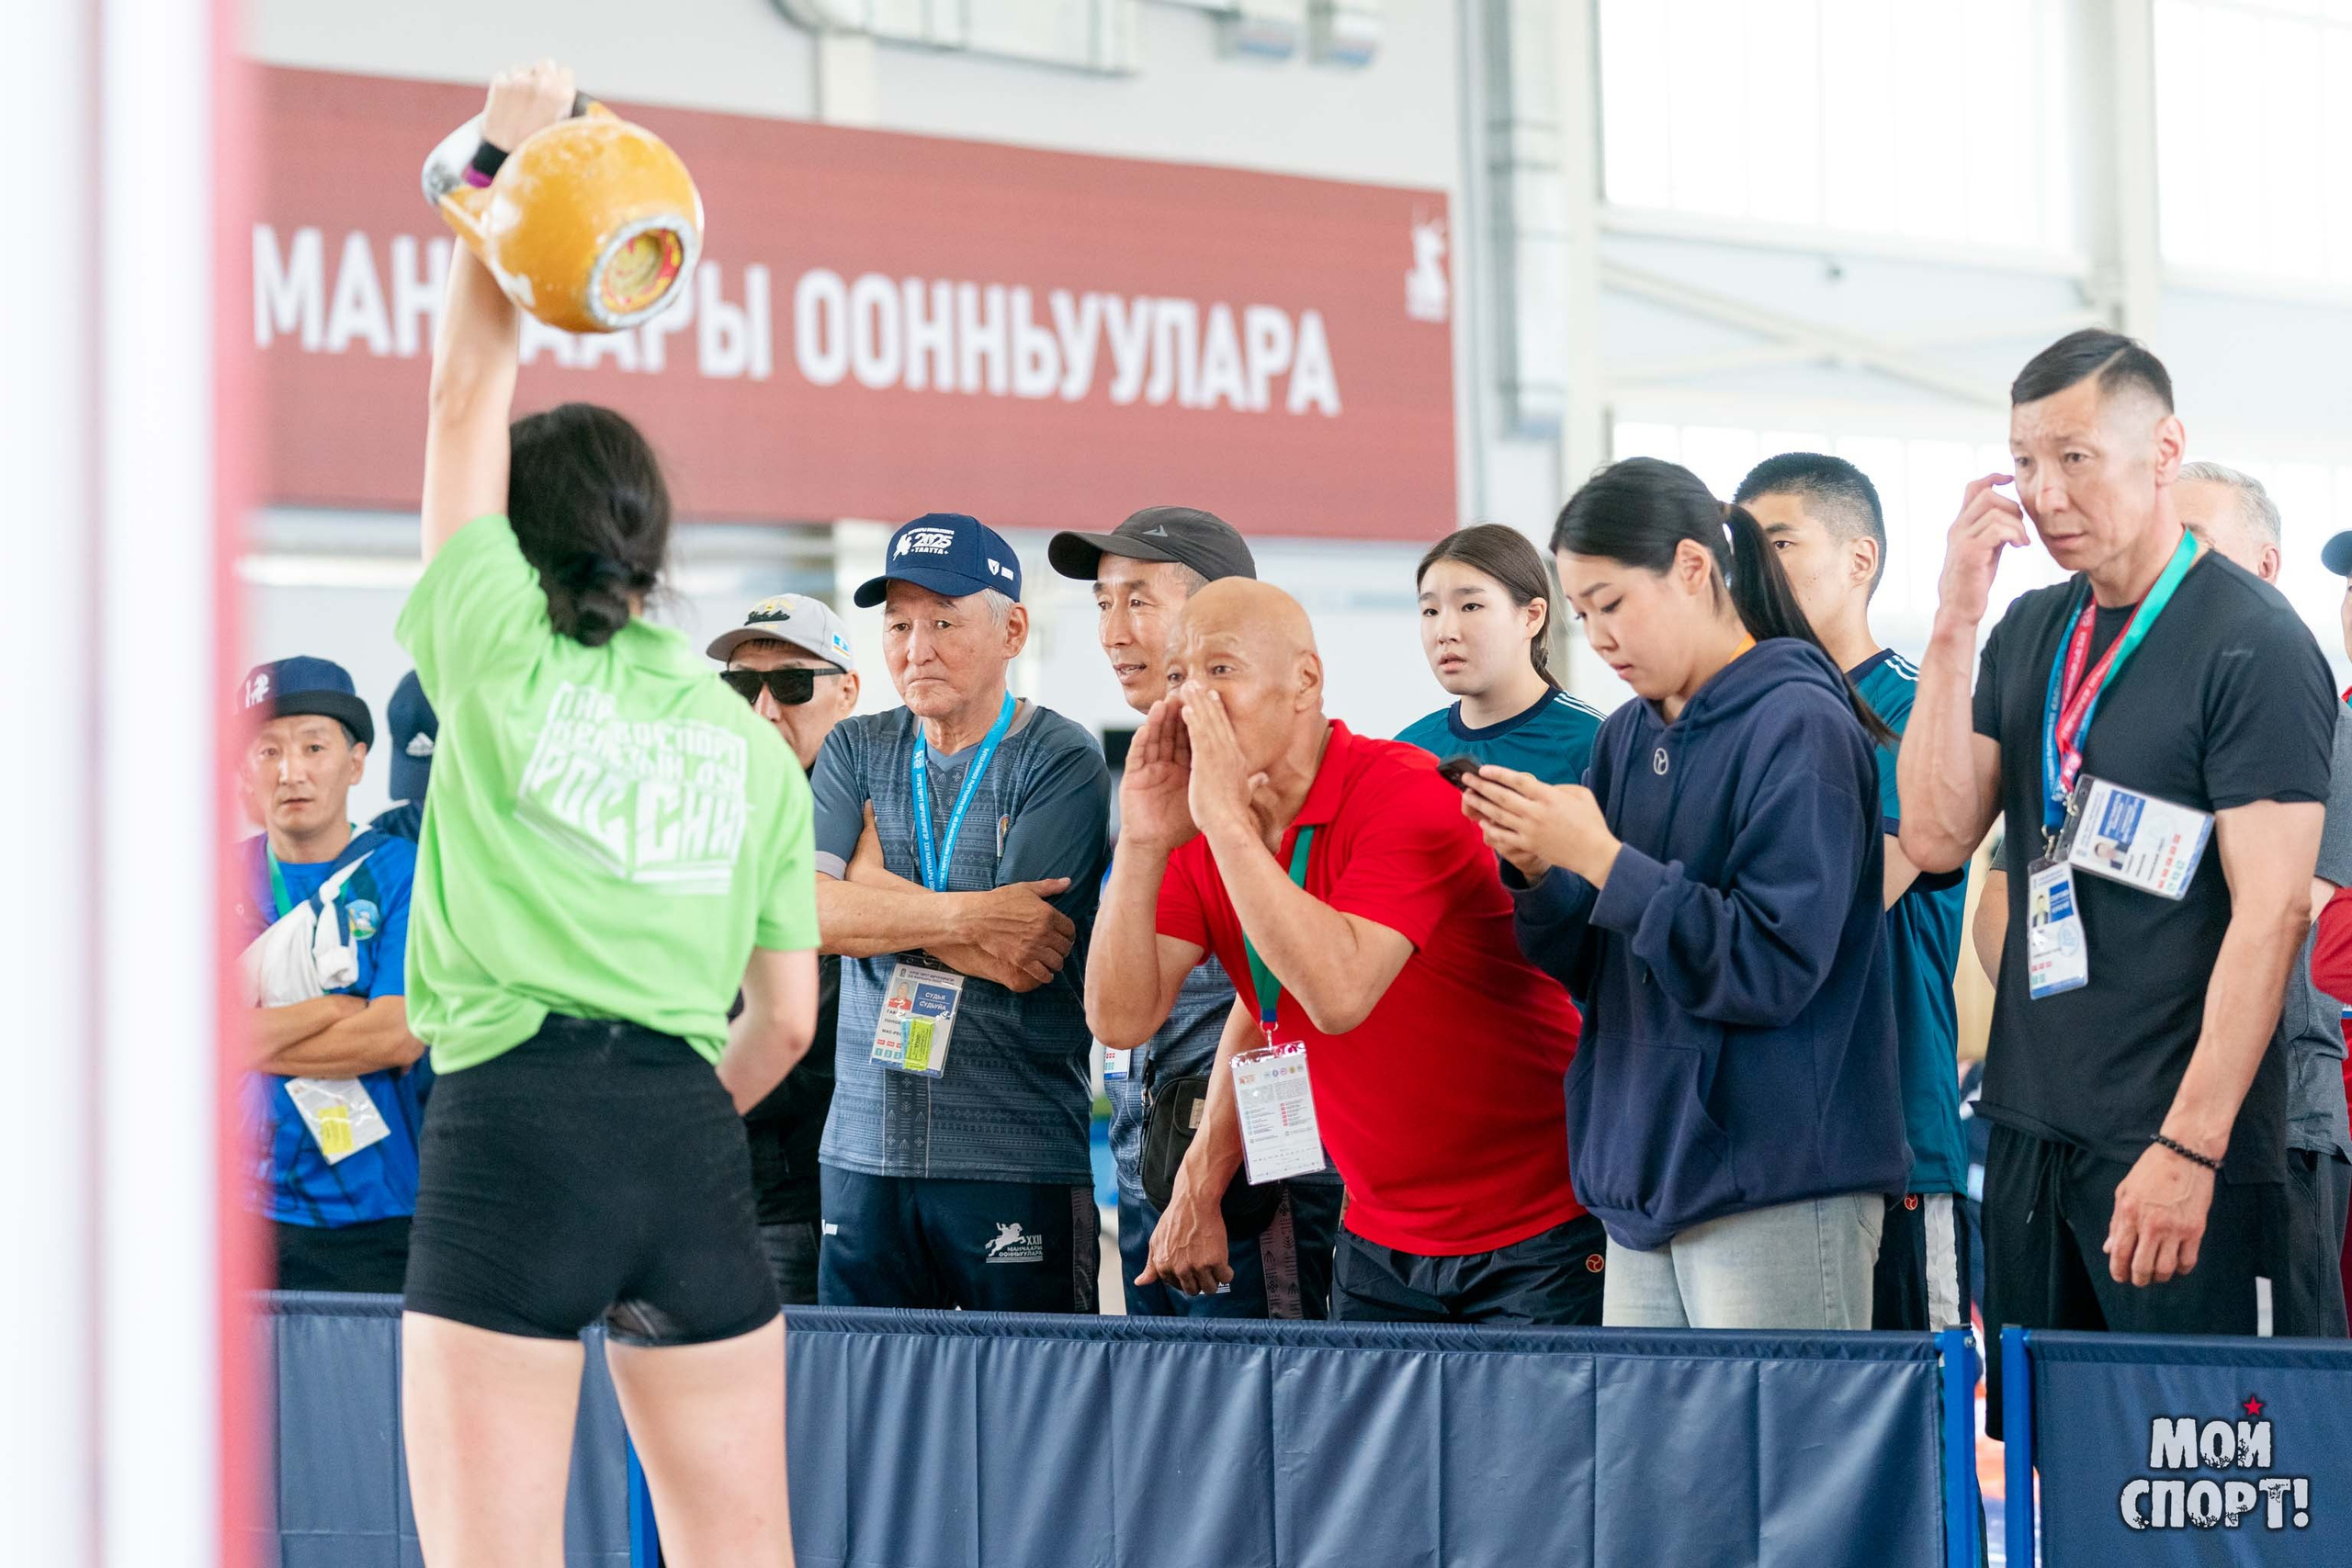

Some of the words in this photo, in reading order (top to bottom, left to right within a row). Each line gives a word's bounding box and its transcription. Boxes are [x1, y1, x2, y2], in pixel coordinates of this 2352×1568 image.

[795, 268, 1341, 417] ООННЬУУЛАРА
[912, 533, 953, 548] 2025
[925, 991, 946, 1000] СУДЬЯ
[1026, 1235, 1043, 1245] XXII
